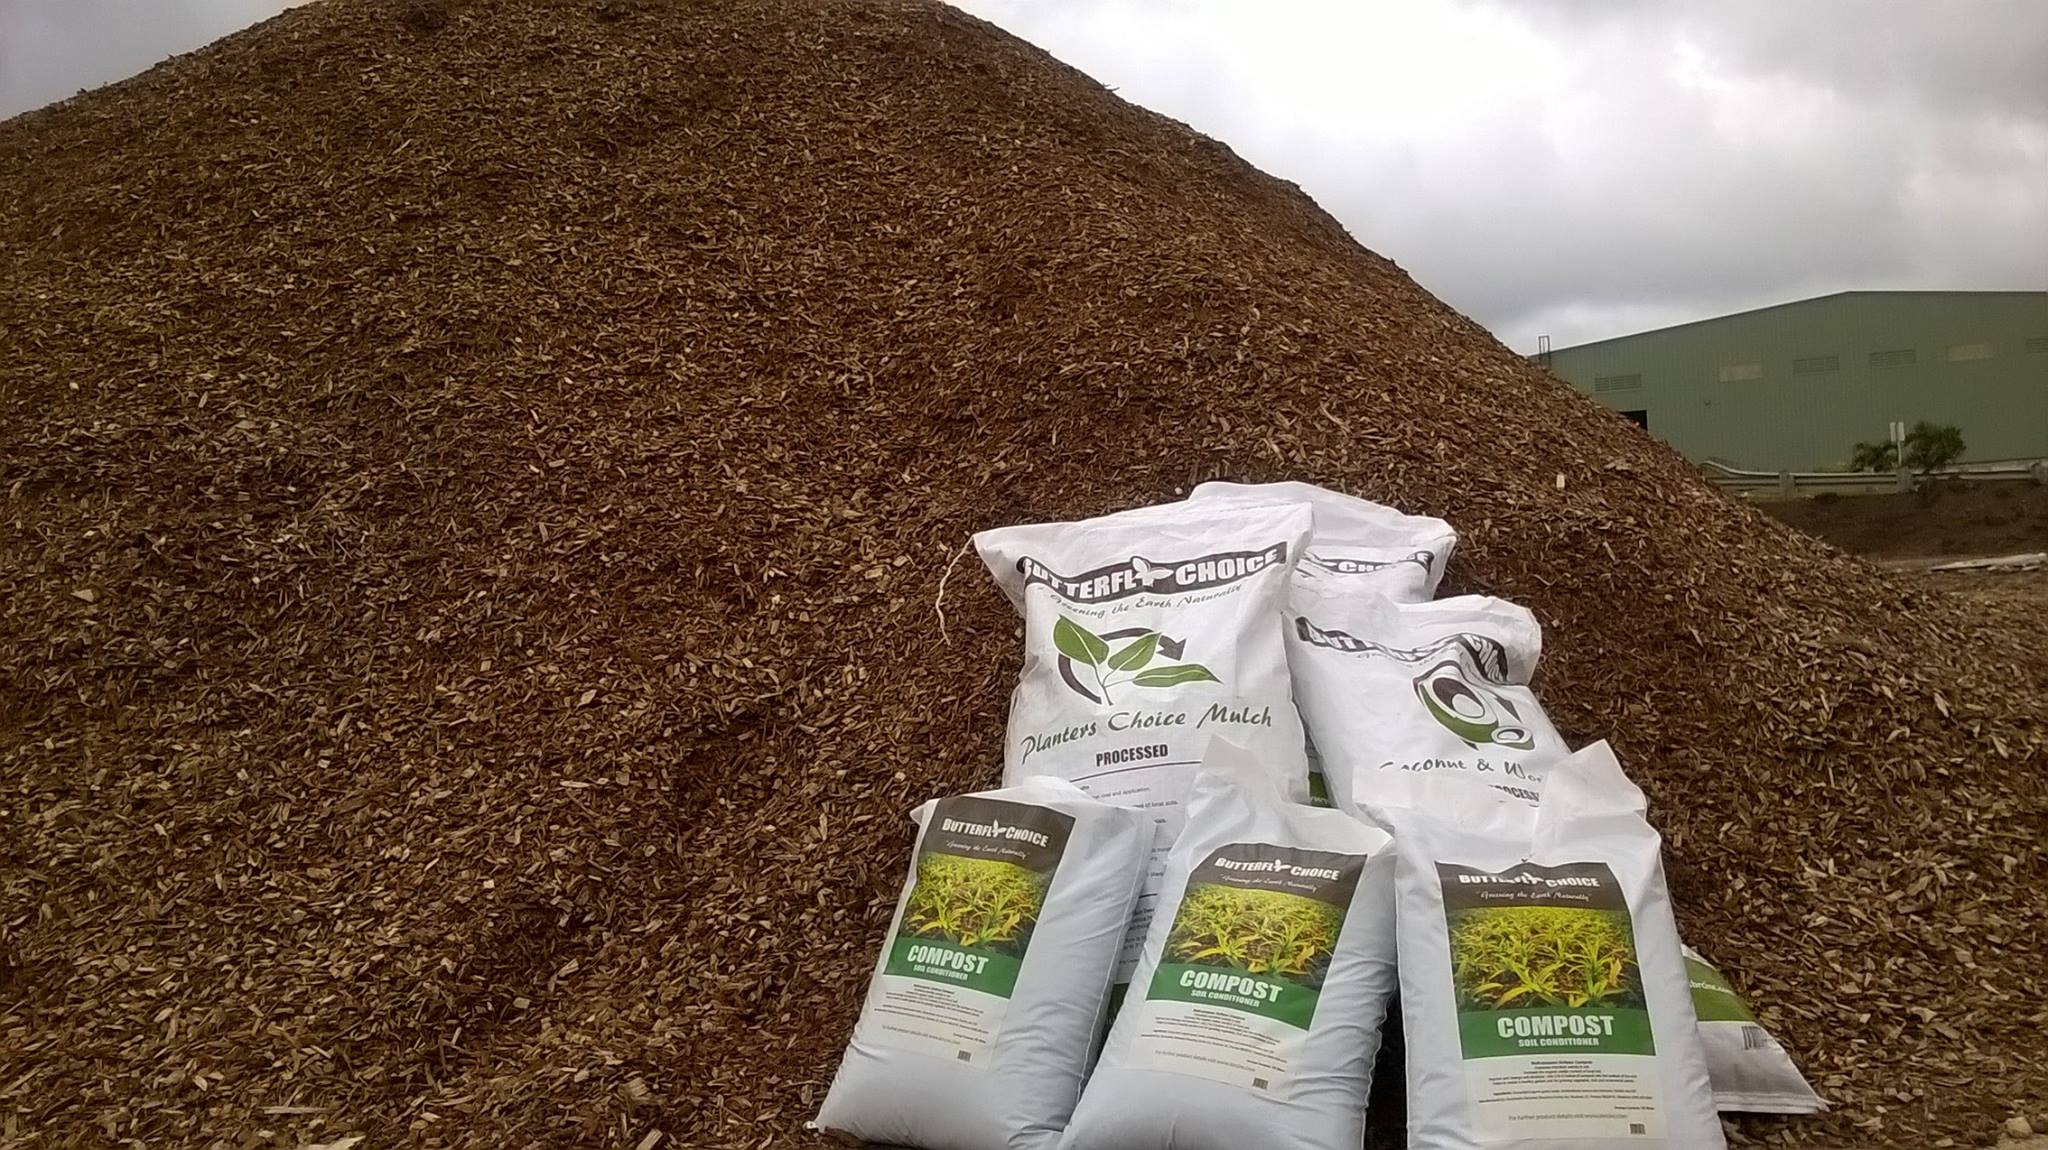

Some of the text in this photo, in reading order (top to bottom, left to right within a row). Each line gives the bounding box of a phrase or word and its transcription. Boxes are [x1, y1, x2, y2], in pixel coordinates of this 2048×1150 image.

[1174, 548, 1280, 586] CHOICE
[1111, 602, 1129, 615] the
[1135, 596, 1172, 609] Earth
[1020, 702, 1272, 765] Planters Choice Mulch
[1095, 743, 1169, 767] PROCESSED
[1379, 758, 1468, 772] conut
[1476, 758, 1495, 772] &
[1005, 826, 1049, 848] CHOICE
[1289, 865, 1341, 881] CHOICE
[1545, 876, 1601, 888] CHOICE
[906, 945, 990, 975] COMPOST
[1179, 969, 1284, 1003] COMPOST
[1190, 989, 1261, 1008] SOIL CONDITIONER
[1496, 1014, 1615, 1038] COMPOST
[1518, 1037, 1600, 1048] SOIL CONDITIONER
